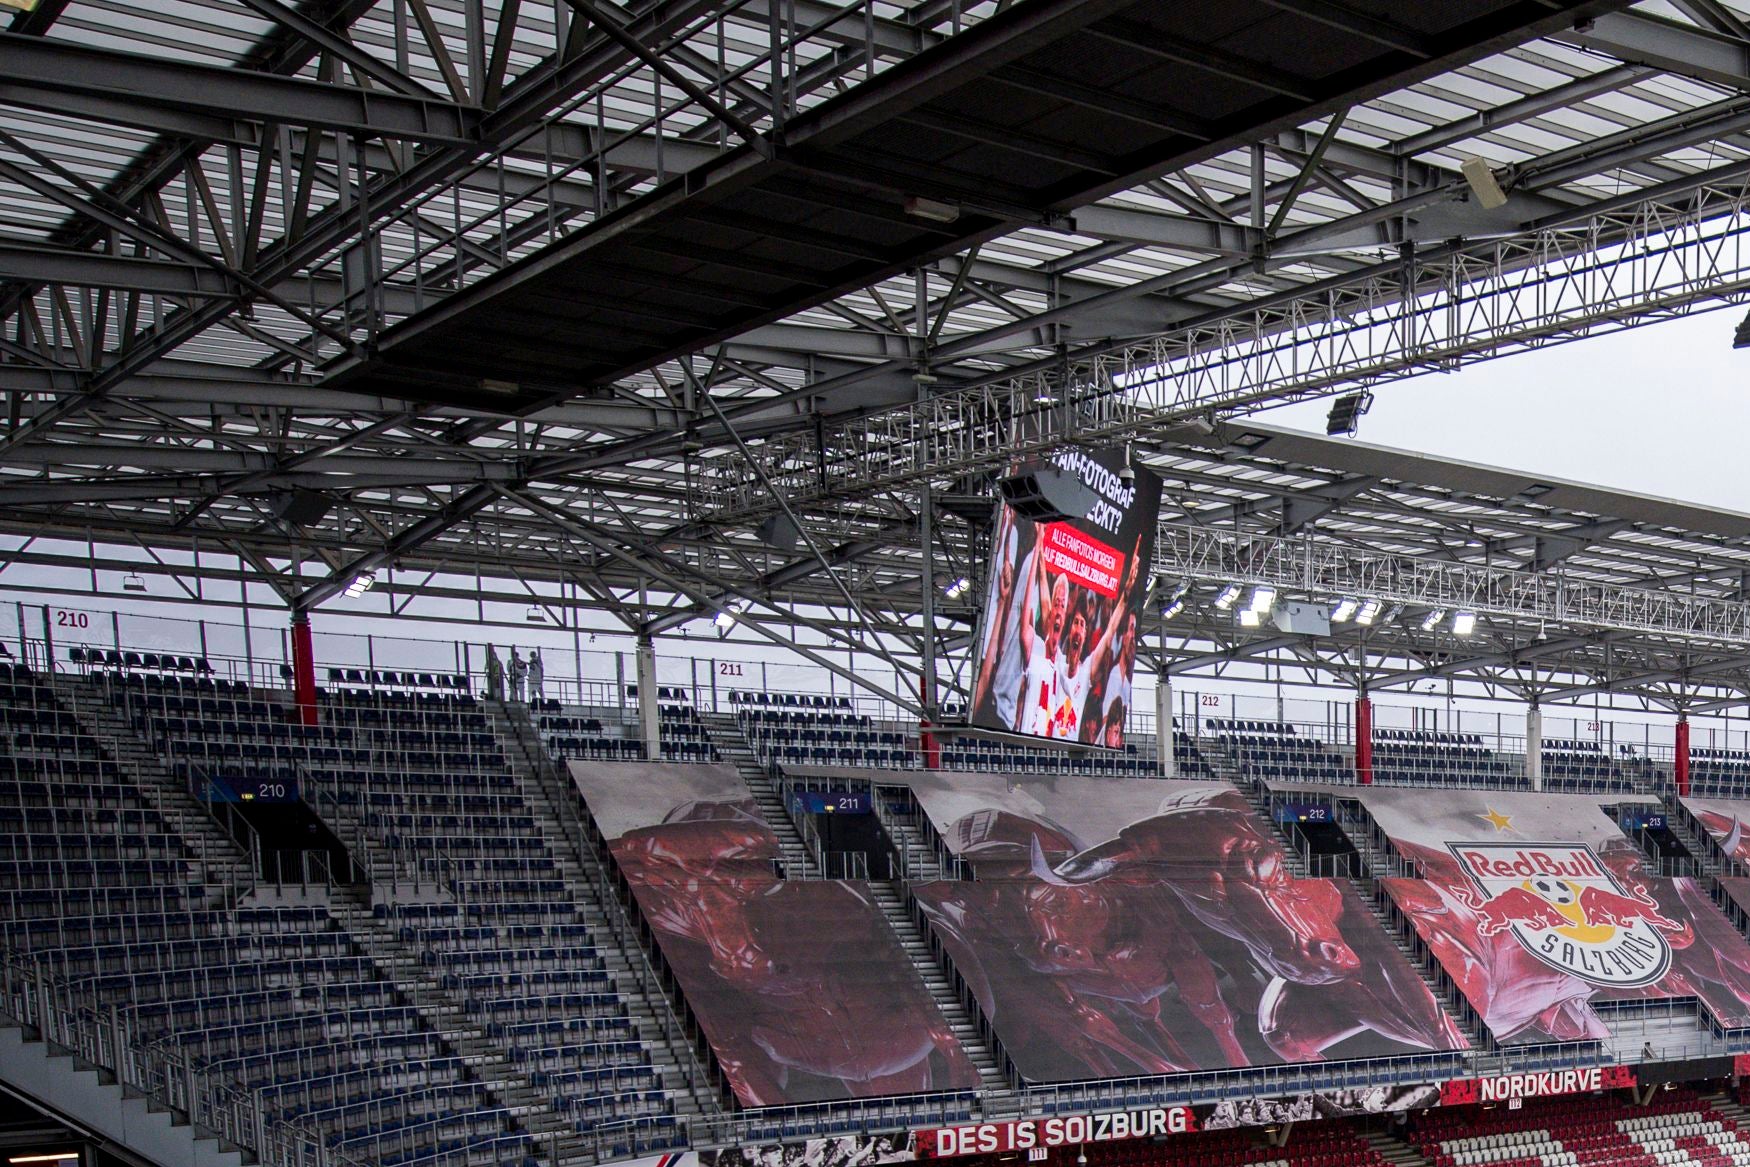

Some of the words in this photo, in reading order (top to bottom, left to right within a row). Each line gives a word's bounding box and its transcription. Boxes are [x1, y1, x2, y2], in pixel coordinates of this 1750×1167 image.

[1093, 546, 1116, 570] MORGEN
[57, 611, 89, 628] 210
[720, 663, 743, 676] 211
[1202, 696, 1219, 706] 212
[259, 784, 285, 798] 210
[839, 798, 859, 809] 211
[1309, 809, 1325, 819] 212
[1649, 817, 1661, 827] 213
[1464, 851, 1532, 877] Red
[1529, 851, 1602, 878] Bull
[1541, 931, 1656, 976] SALZBURG
[1481, 1068, 1602, 1100] NORDKURVE
[937, 1124, 998, 1157] DES
[1008, 1121, 1036, 1150] IS
[1045, 1107, 1187, 1145] SOIZBURG
